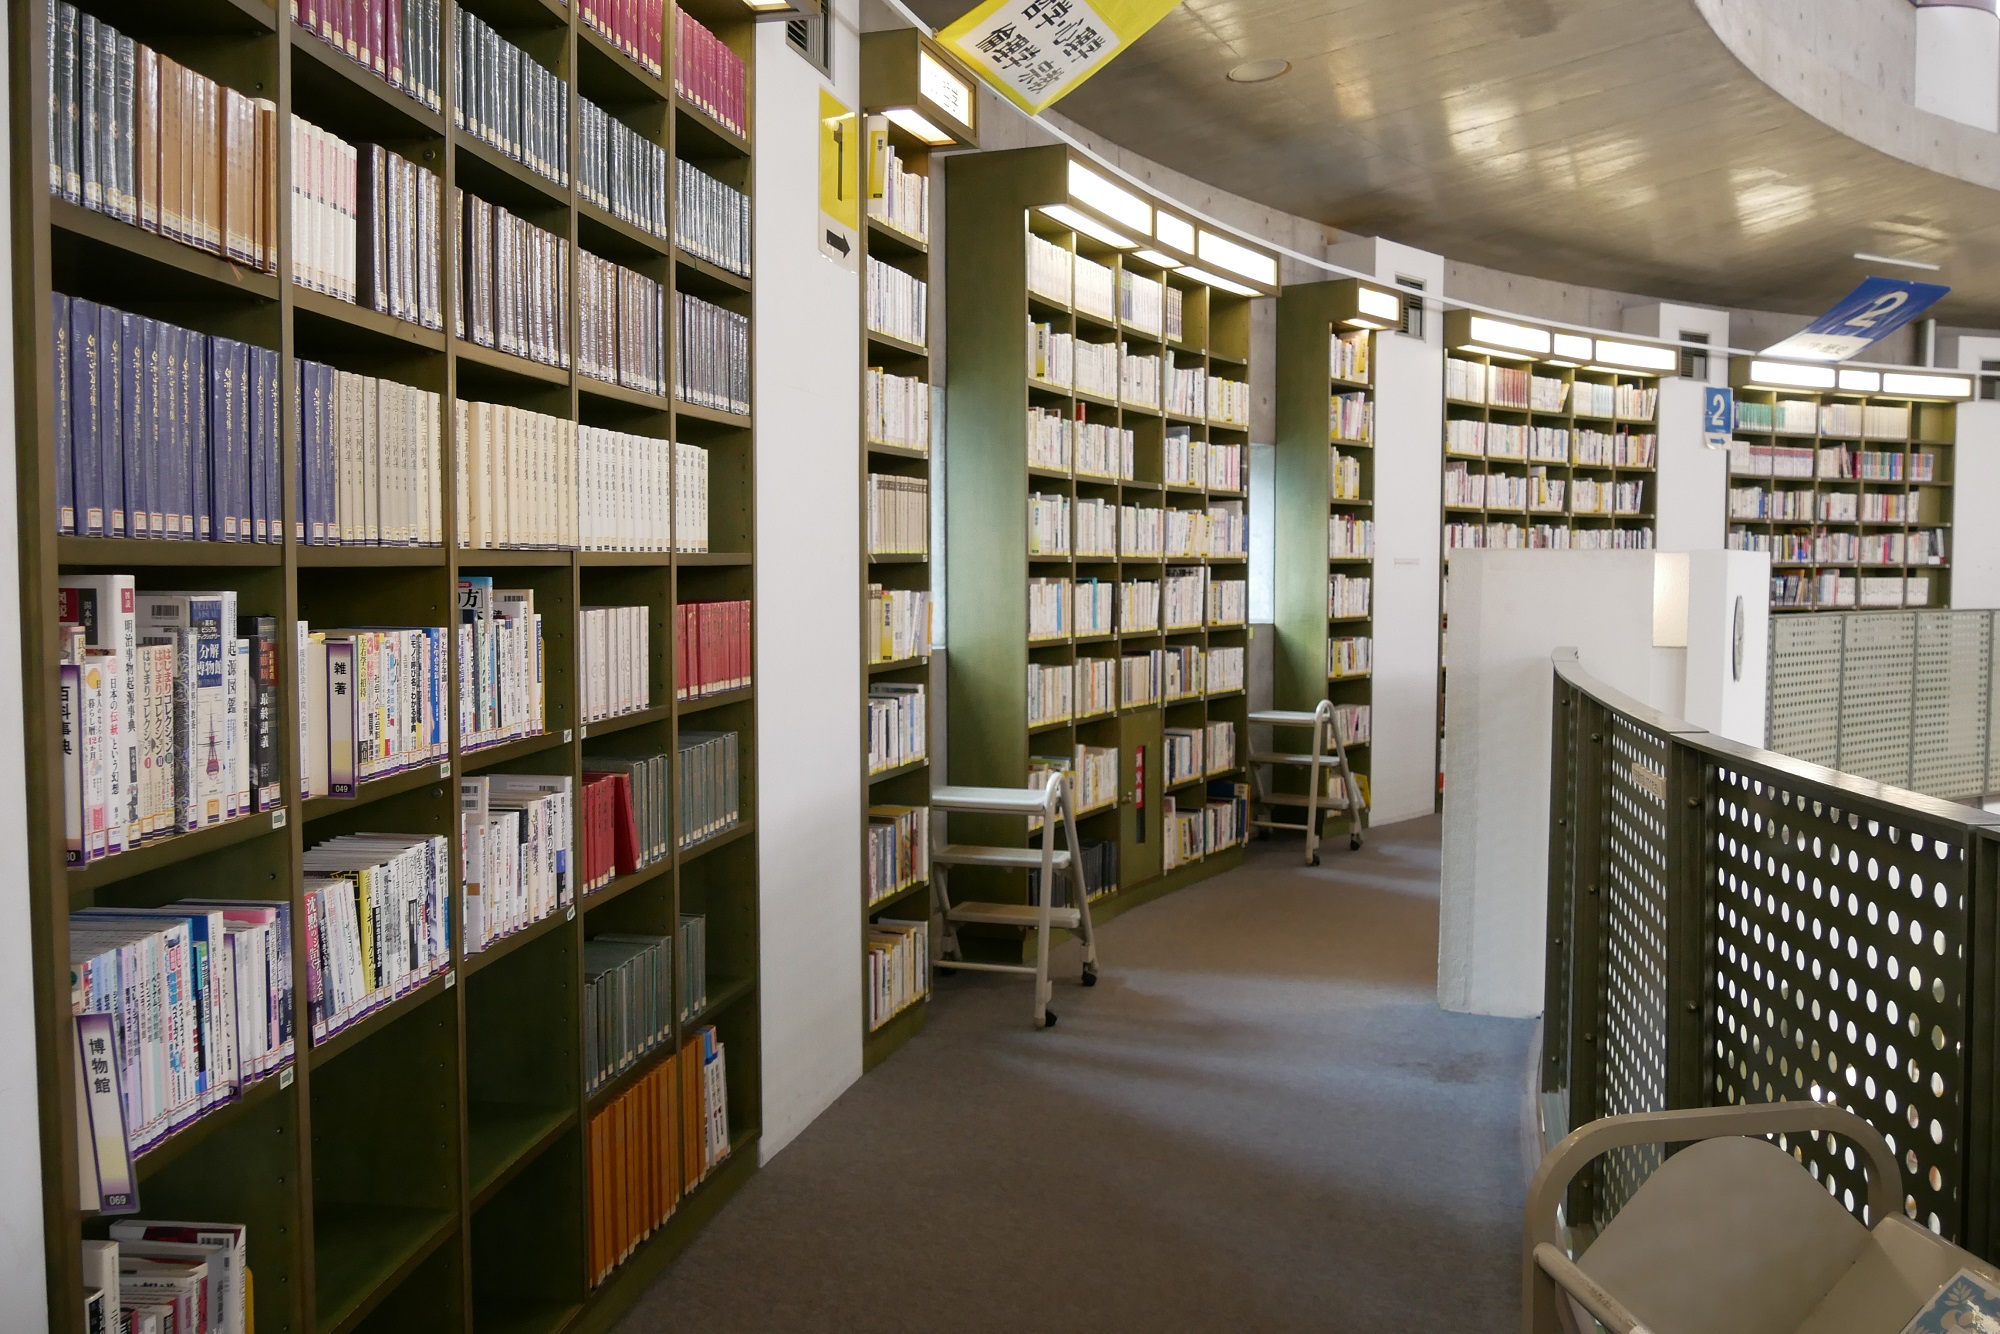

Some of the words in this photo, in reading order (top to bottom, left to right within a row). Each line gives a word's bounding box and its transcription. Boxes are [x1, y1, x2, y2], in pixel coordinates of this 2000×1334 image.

[1844, 290, 1909, 328] 2
[1712, 393, 1725, 426] 2
[124, 620, 136, 734] 明治事物起源事典
[200, 643, 220, 659] 分解
[227, 640, 237, 714] 起源図鑑
[333, 661, 347, 696] 雑著
[143, 650, 151, 757] はじまりコレクション
[154, 650, 163, 756] はじまりコレクション
[163, 649, 173, 753] はじまりコレクション
[335, 784, 349, 793] 049
[546, 799, 554, 874] 地方紙の研究
[88, 1038, 111, 1094] 博物館
[109, 1194, 127, 1206] 069
